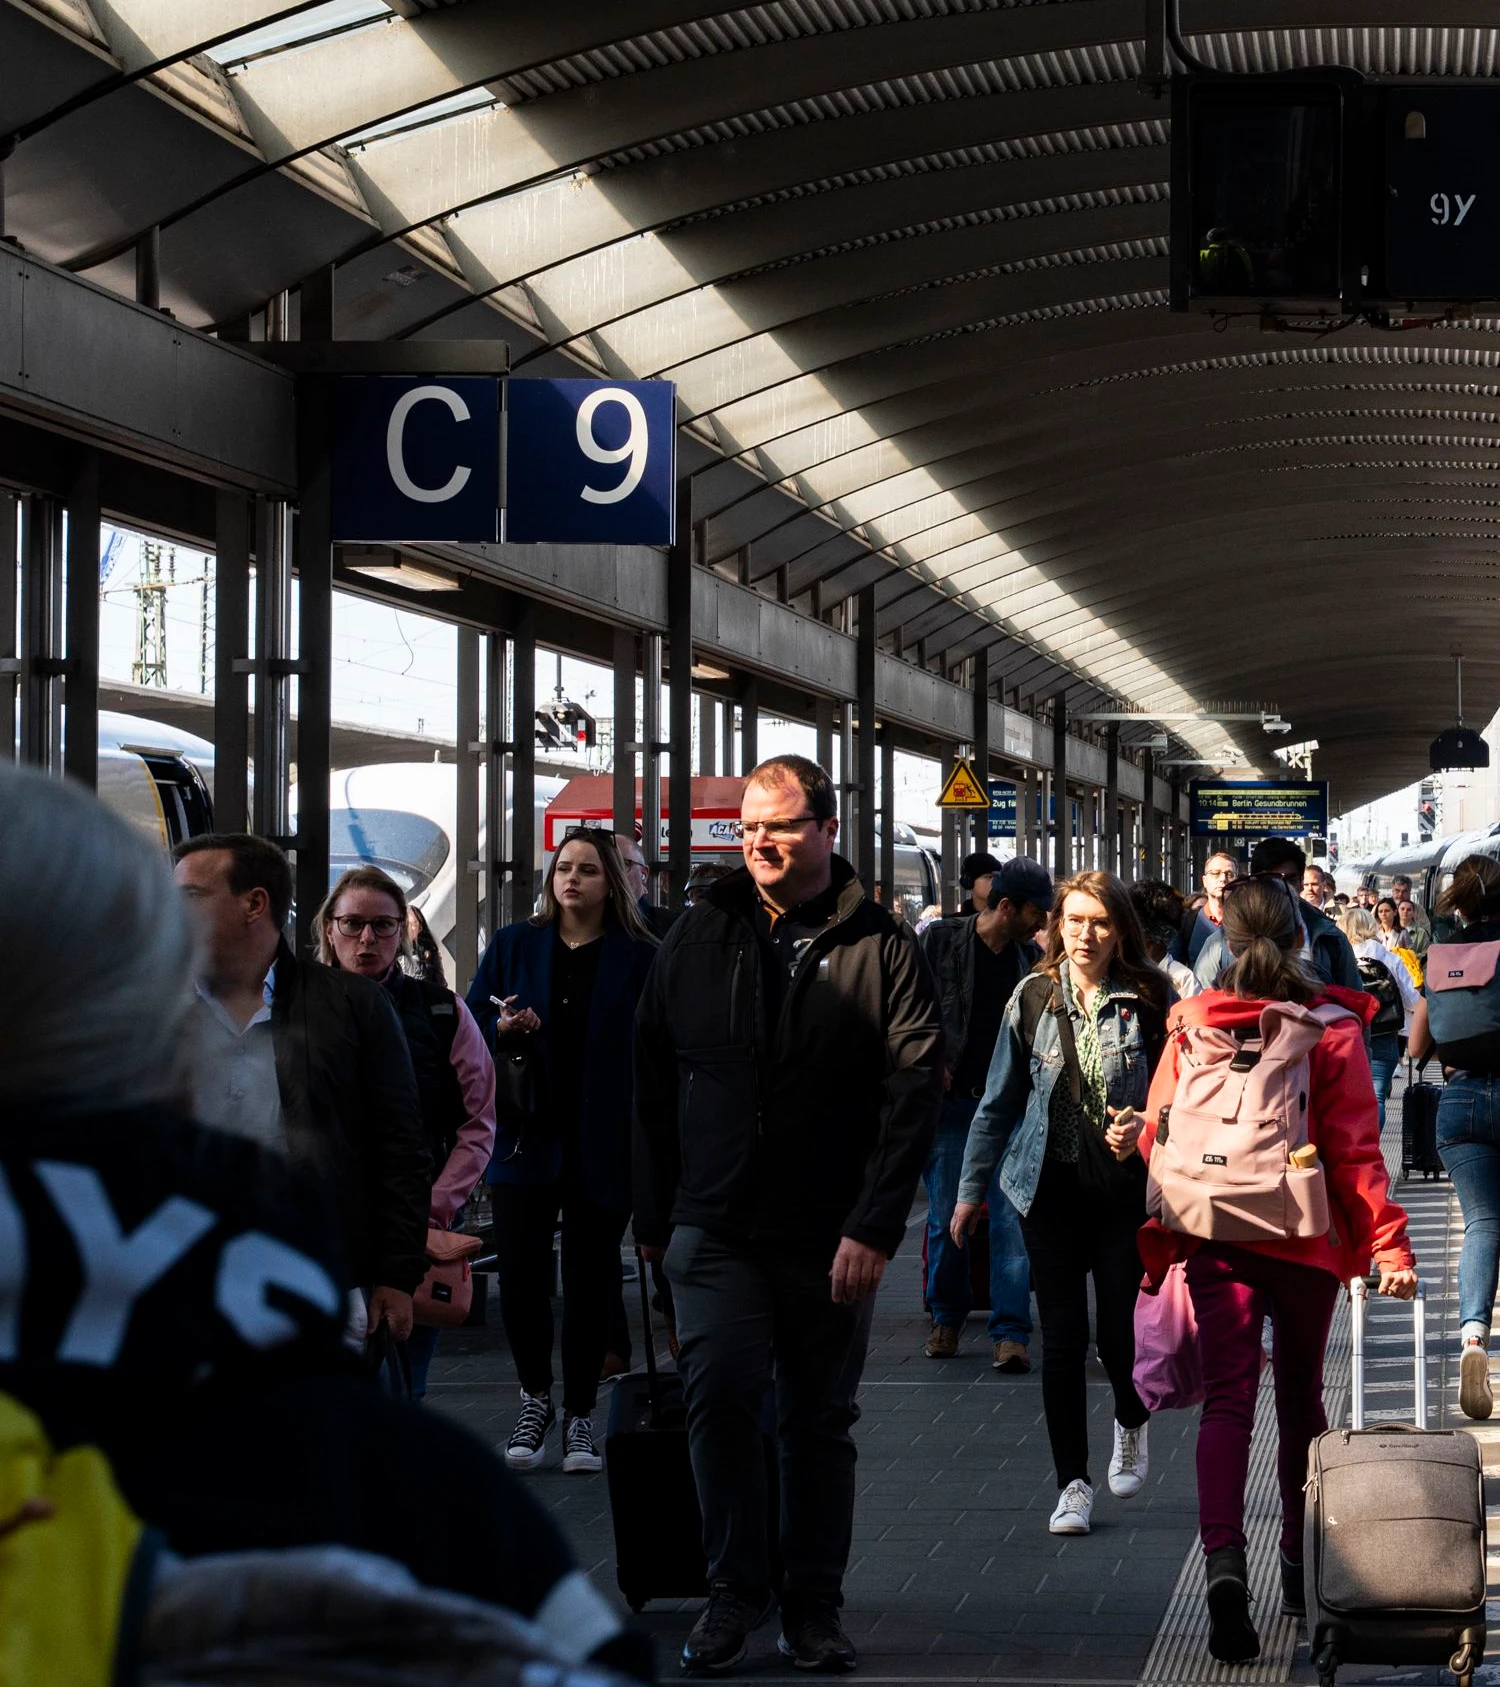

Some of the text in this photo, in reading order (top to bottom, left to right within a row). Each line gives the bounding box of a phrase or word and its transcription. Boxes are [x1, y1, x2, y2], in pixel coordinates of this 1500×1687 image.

[386, 385, 472, 504] C
[575, 387, 649, 505] 9
[992, 799, 1006, 809] Zug
[1232, 799, 1253, 807] Berlin
[1254, 799, 1308, 807] Gesundbrunnen
